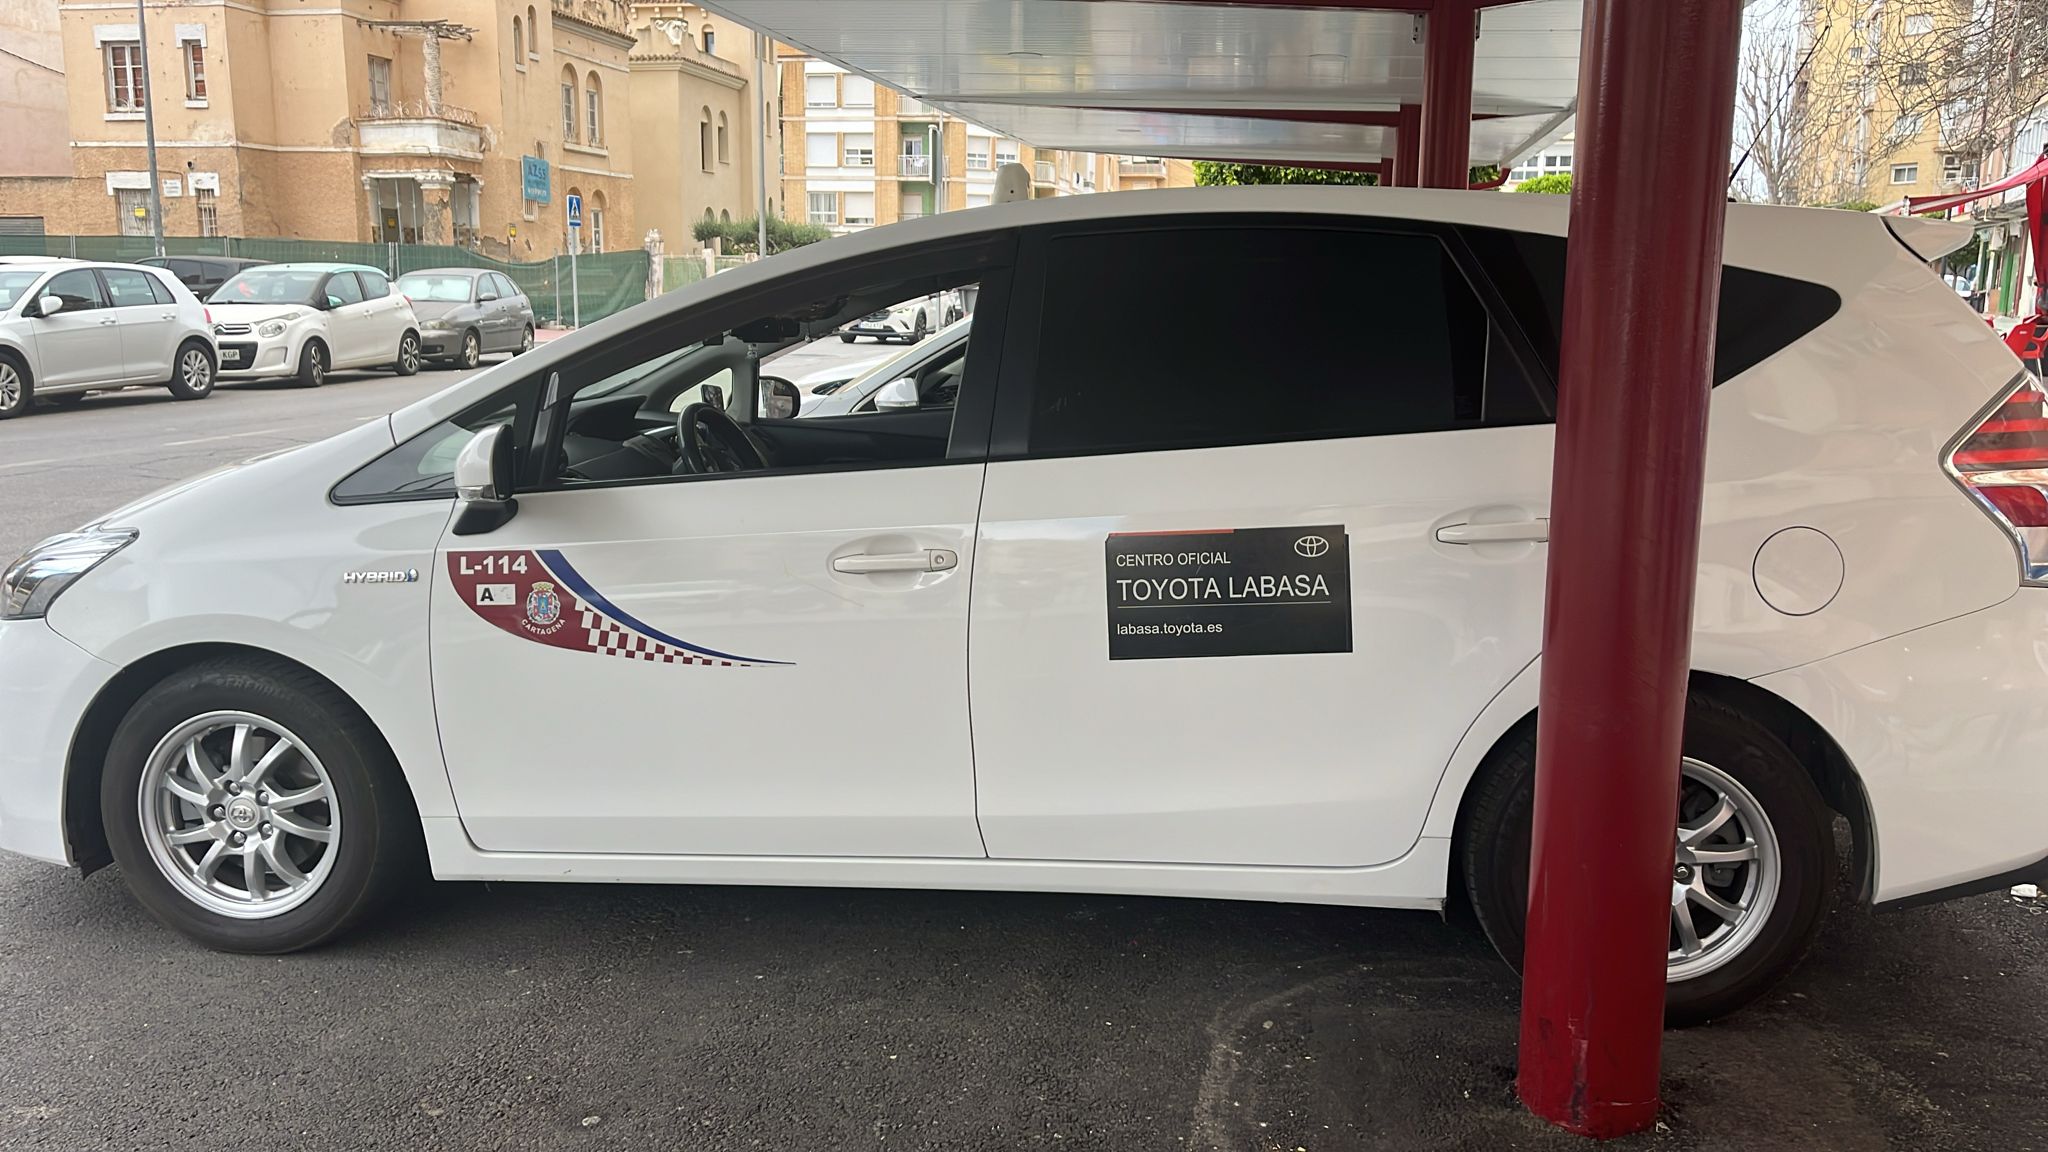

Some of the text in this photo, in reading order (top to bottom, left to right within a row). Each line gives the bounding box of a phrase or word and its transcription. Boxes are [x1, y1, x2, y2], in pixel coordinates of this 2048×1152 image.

[222, 351, 238, 359] KGP
[460, 555, 528, 575] L-114
[1116, 551, 1231, 567] CENTRO OFICIAL
[343, 571, 406, 583] HYBRID
[480, 588, 494, 602] A
[1116, 574, 1330, 601] TOYOTA LABASA
[521, 618, 566, 635] CARTAGENA
[1117, 622, 1223, 637] labasa.toyota.es
